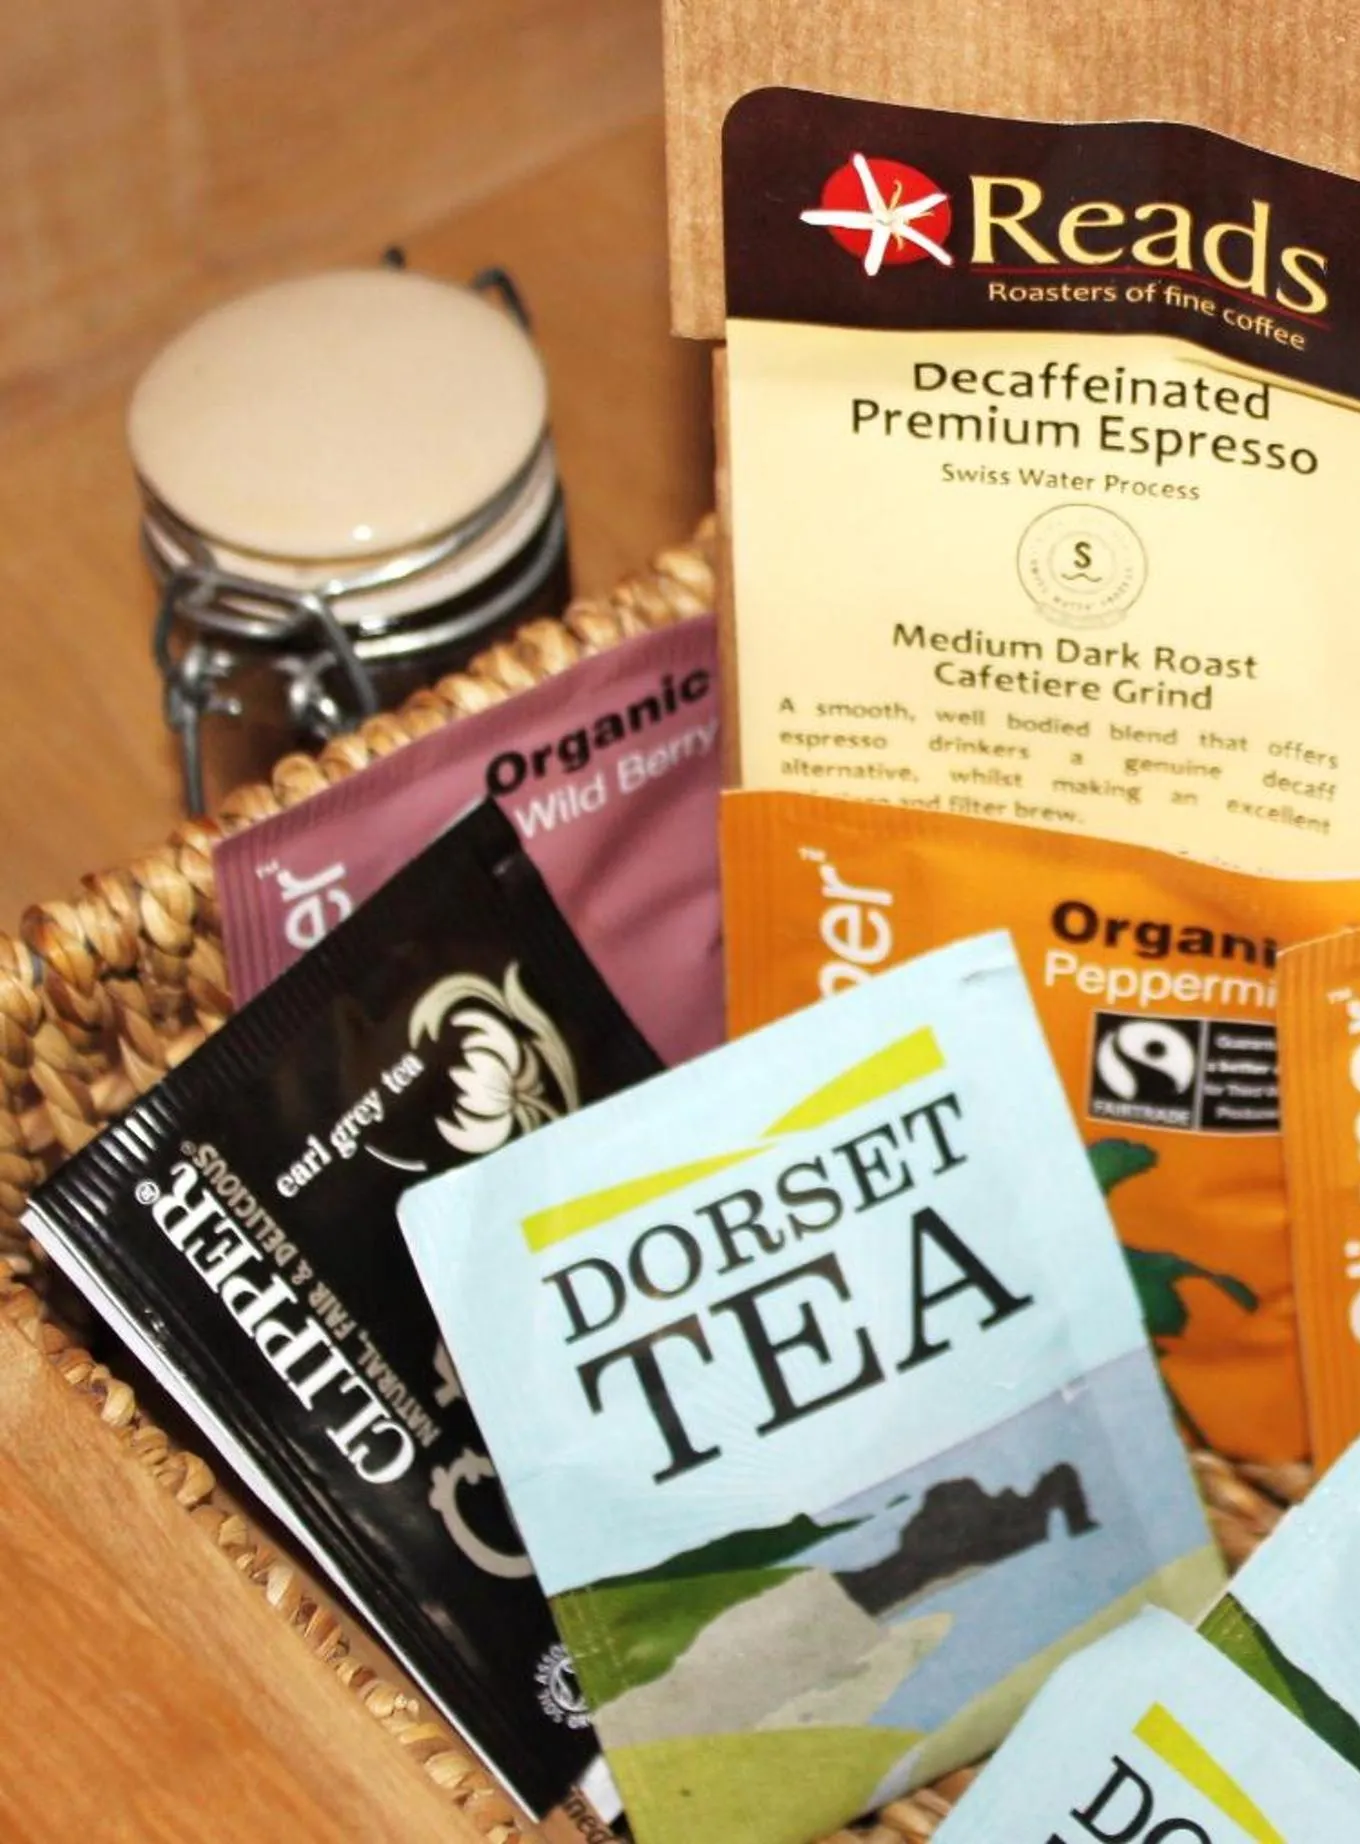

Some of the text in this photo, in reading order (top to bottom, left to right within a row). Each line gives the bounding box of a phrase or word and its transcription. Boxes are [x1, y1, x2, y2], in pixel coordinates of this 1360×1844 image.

[969, 174, 1330, 316] Reads
[988, 280, 1306, 351] Roasters of fine coffee
[913, 360, 1271, 421] Decaffeinated
[850, 398, 1320, 476] Premium Espresso
[941, 462, 1201, 501] Swiss Water Process
[892, 622, 1259, 681] Medium Dark Roast
[933, 662, 1214, 711] Cafetiere Grind
[486, 666, 711, 798] Organic
[779, 697, 1339, 769] A smooth, well bodied blend that offers
[779, 729, 1337, 802] espresso drinkers a genuine decaff
[514, 718, 718, 839] Wild Berry
[781, 758, 1331, 835] alternative, whilst making an excellent
[277, 1052, 425, 1198] earl grey tea
[541, 1091, 968, 1345] DORSET
[291, 1258, 313, 1285] &
[309, 1281, 357, 1340] FAIR
[575, 1205, 1035, 1486] TEA
